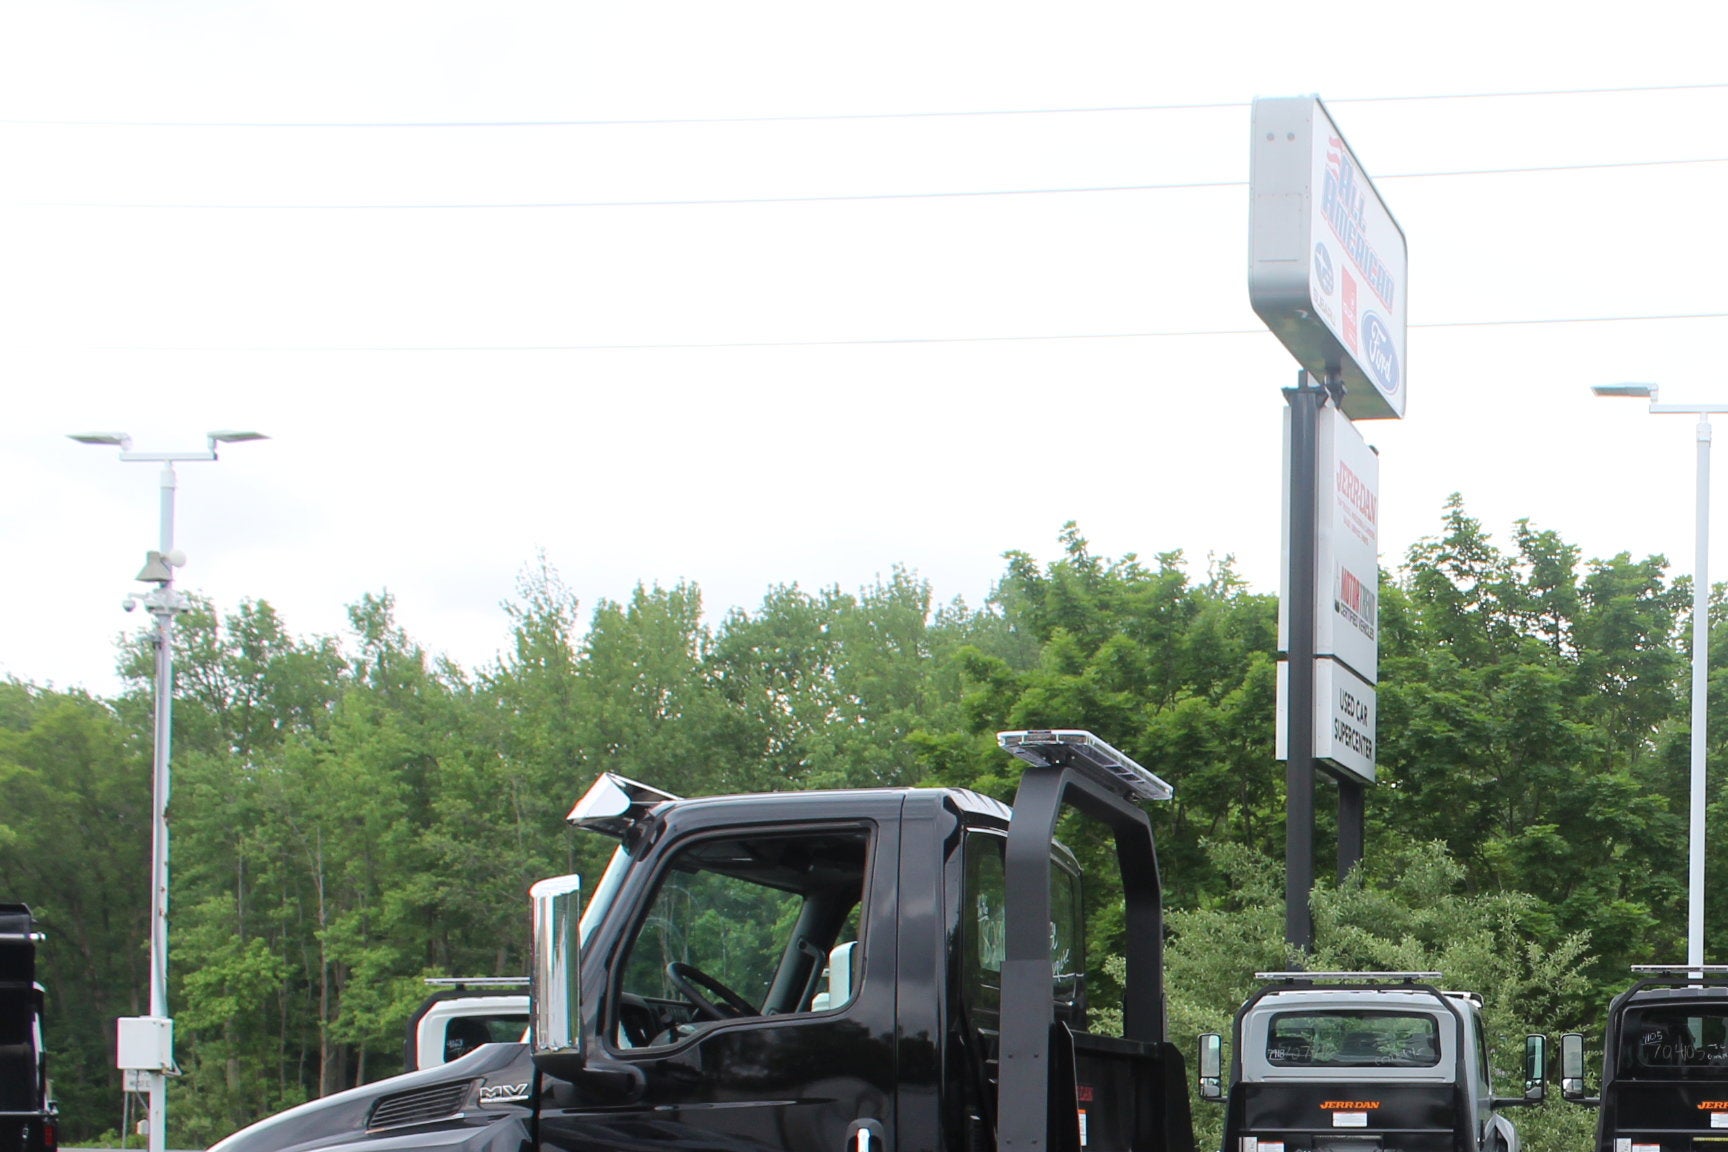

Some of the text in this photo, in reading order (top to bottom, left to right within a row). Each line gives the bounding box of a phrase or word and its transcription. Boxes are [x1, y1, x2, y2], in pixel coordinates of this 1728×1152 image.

[1369, 321, 1392, 383] Ford
[1339, 687, 1368, 728] USED CAR
[1334, 716, 1373, 762] SUPERCENTER
[479, 1082, 529, 1100] MV
